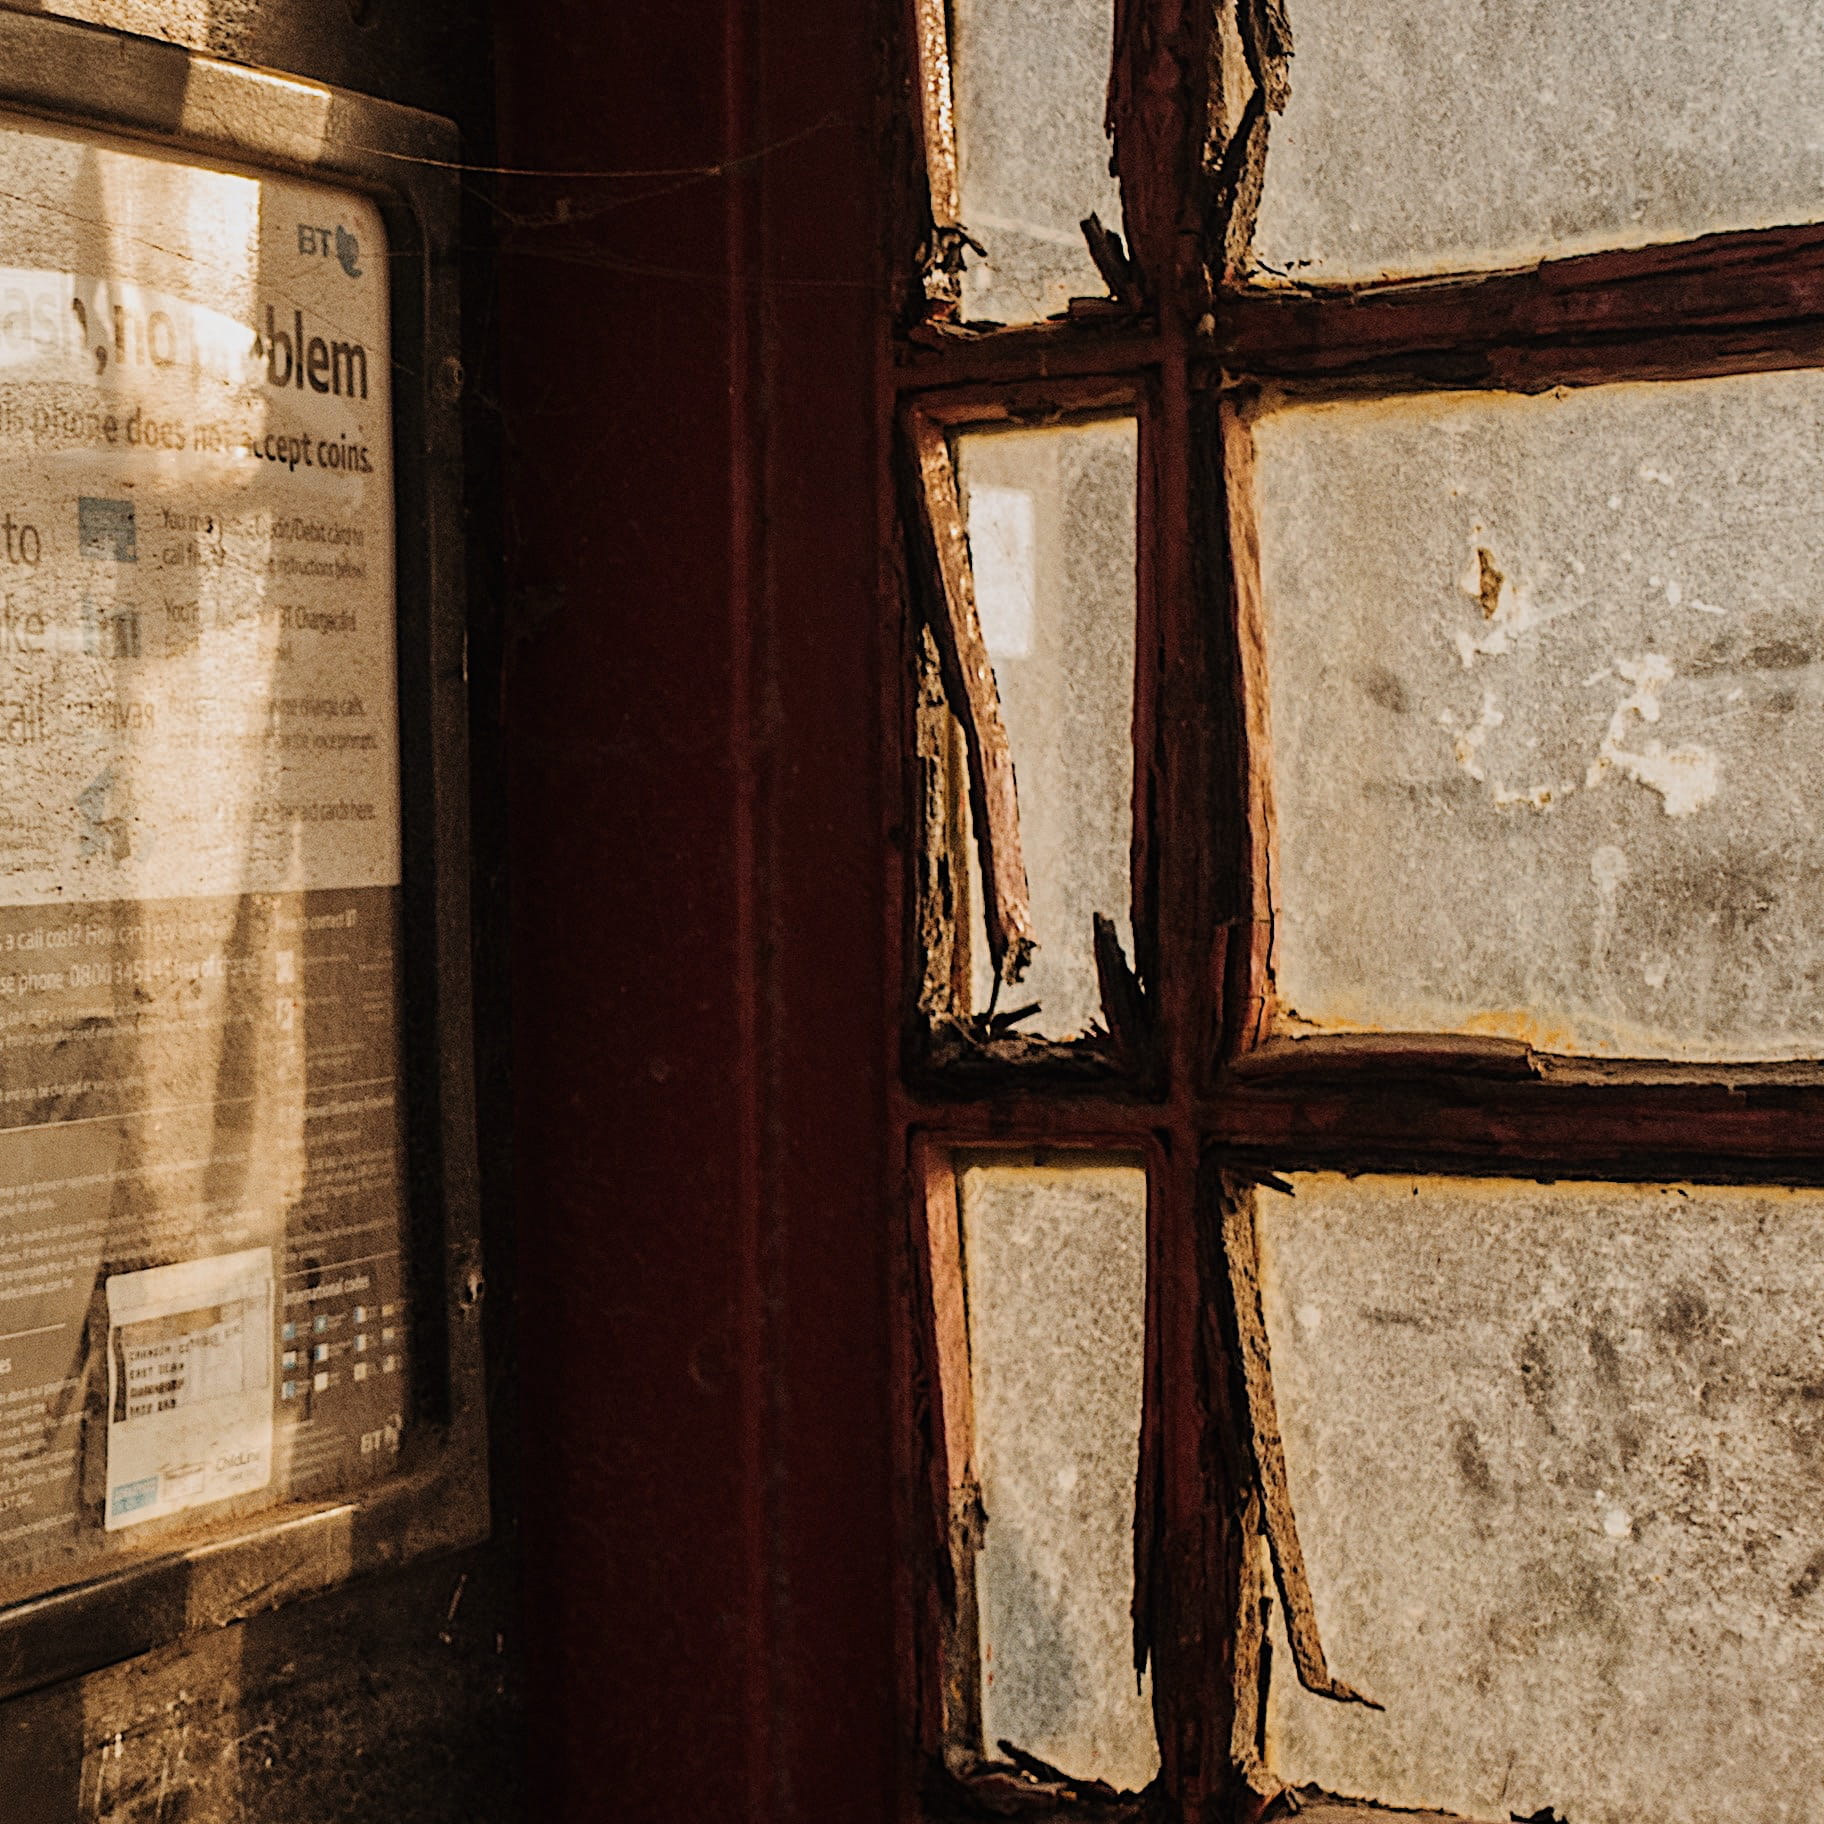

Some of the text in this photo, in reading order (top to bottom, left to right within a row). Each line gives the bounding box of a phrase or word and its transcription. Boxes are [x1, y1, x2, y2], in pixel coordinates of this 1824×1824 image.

[297, 224, 332, 257] BT
[190, 303, 368, 399] blem
[127, 407, 186, 451] does
[0, 512, 41, 565] to
